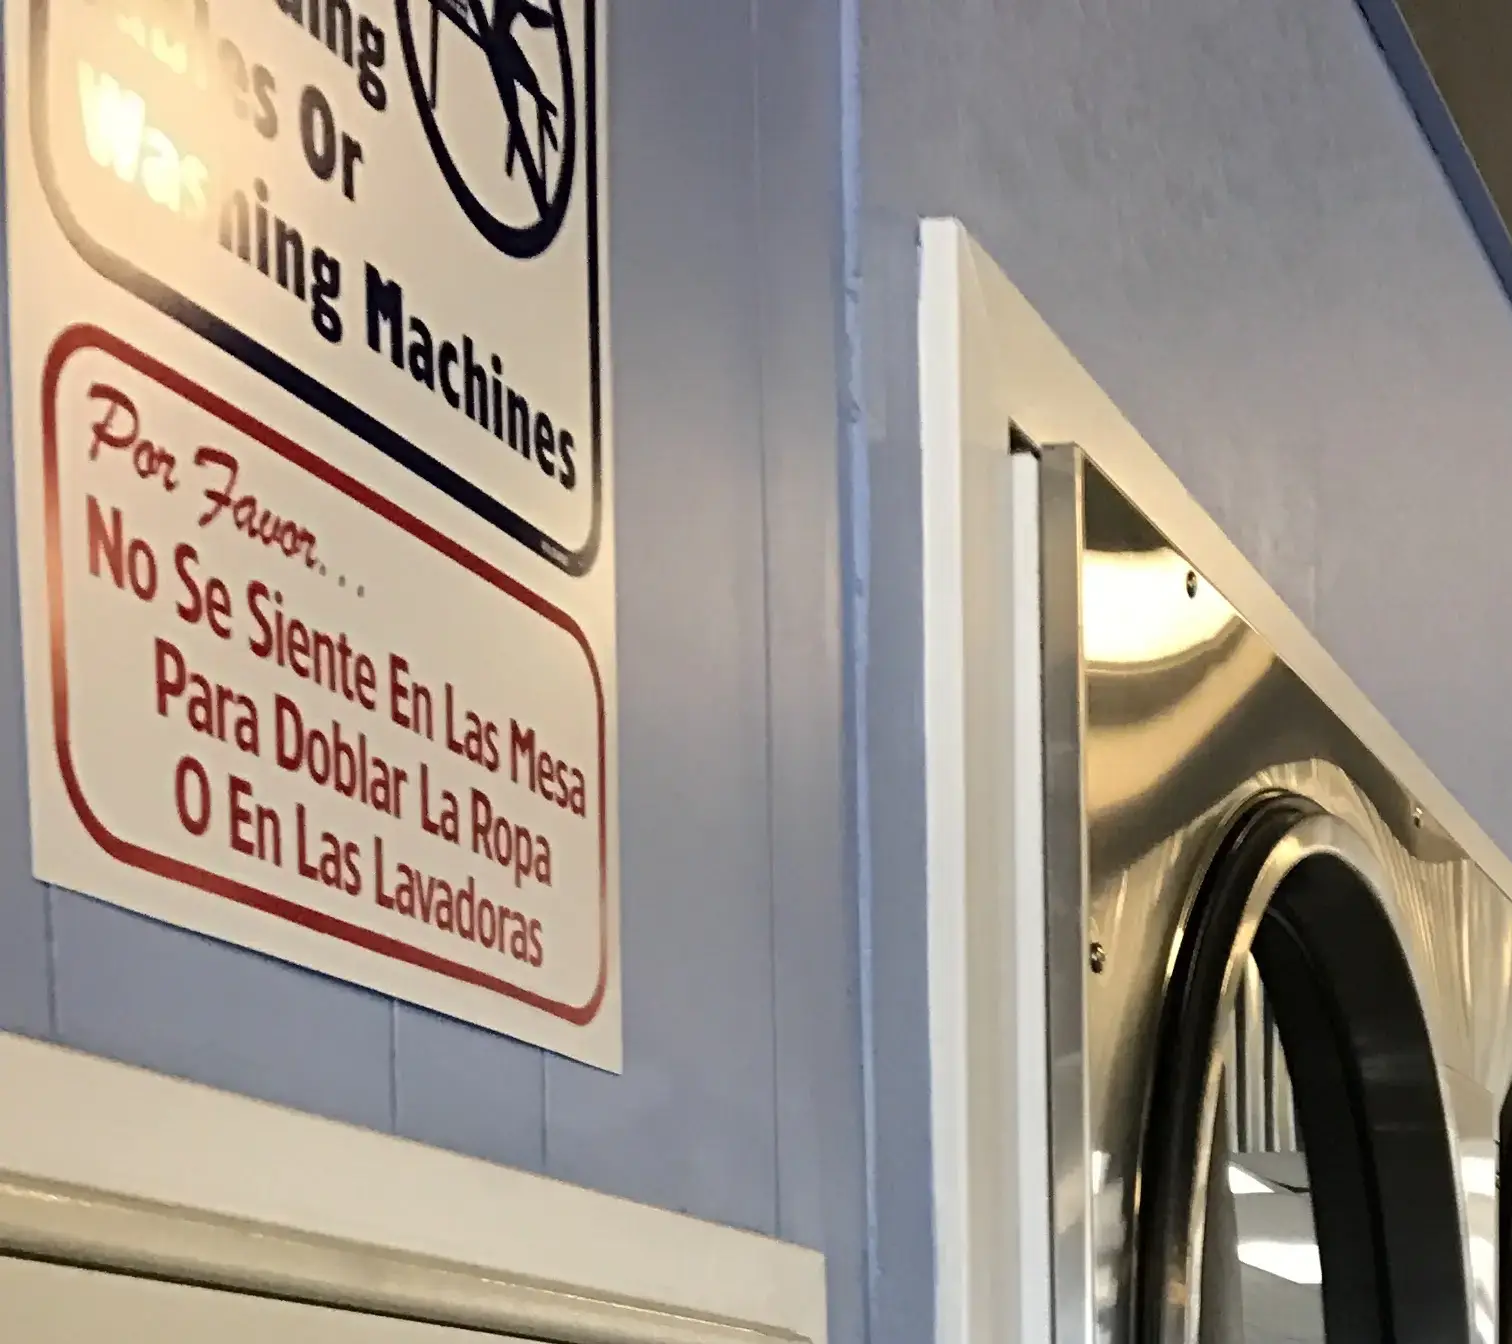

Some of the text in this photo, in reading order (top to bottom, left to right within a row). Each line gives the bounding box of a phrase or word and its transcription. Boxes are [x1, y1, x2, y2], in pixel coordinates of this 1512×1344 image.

[299, 84, 364, 203] Or
[87, 381, 179, 493] Por
[365, 261, 577, 491] Machines
[86, 492, 586, 818] No Se Siente En Las Mesa
[154, 636, 552, 888] Para Doblar La Ropa
[175, 754, 543, 968] O En Las Lavadoras
